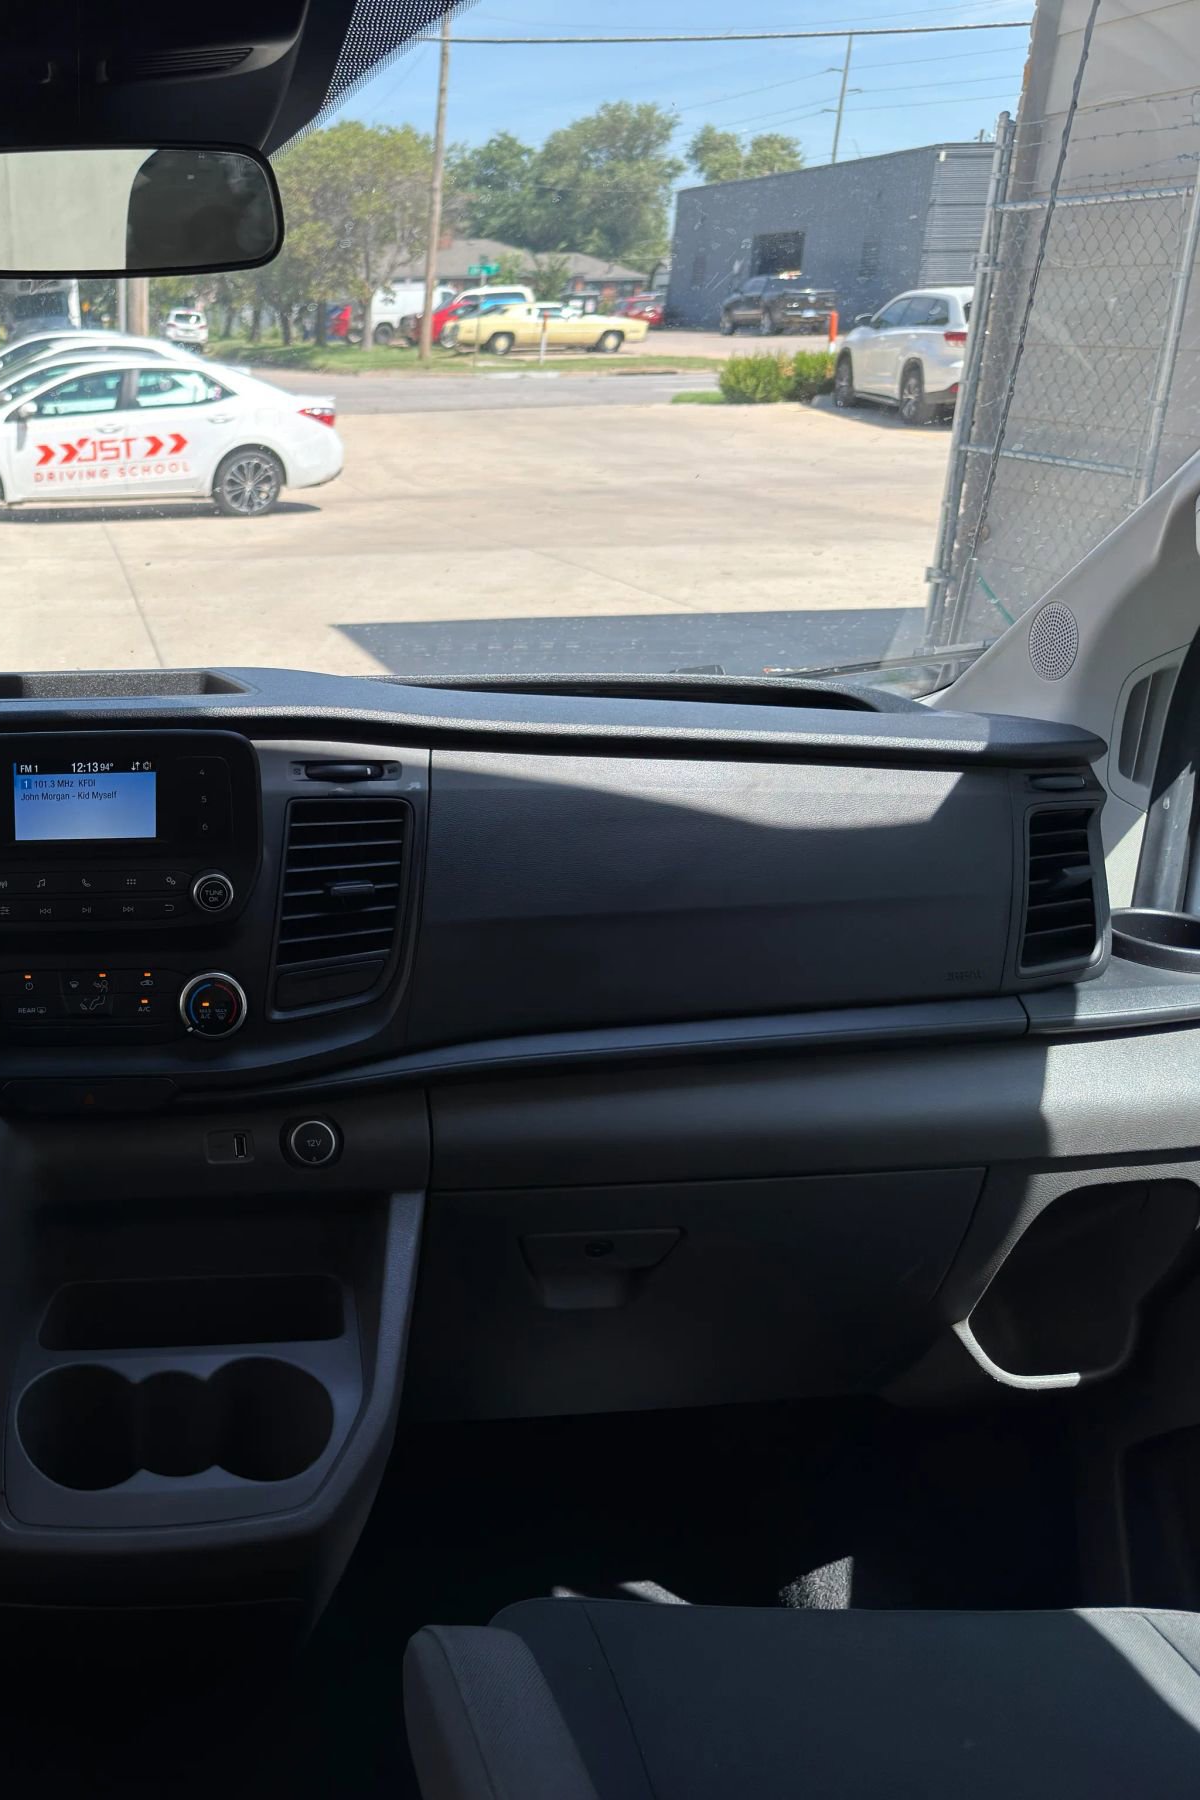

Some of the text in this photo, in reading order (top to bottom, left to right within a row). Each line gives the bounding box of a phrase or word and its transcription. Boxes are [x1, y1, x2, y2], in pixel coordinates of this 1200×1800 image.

[33, 462, 190, 482] DRIVING SCHOOL
[20, 764, 32, 773] FM
[34, 764, 39, 773] 1
[71, 762, 99, 773] 12:13
[199, 768, 206, 776] 4
[34, 779, 56, 789] 101.3
[57, 779, 74, 788] MHz
[78, 779, 96, 787] KFDI
[21, 793, 39, 801] John
[41, 792, 70, 802] Morgan
[77, 791, 90, 800] Kid
[92, 790, 117, 801] Myself
[202, 823, 208, 831] 6
[306, 1139, 322, 1148] 12V
